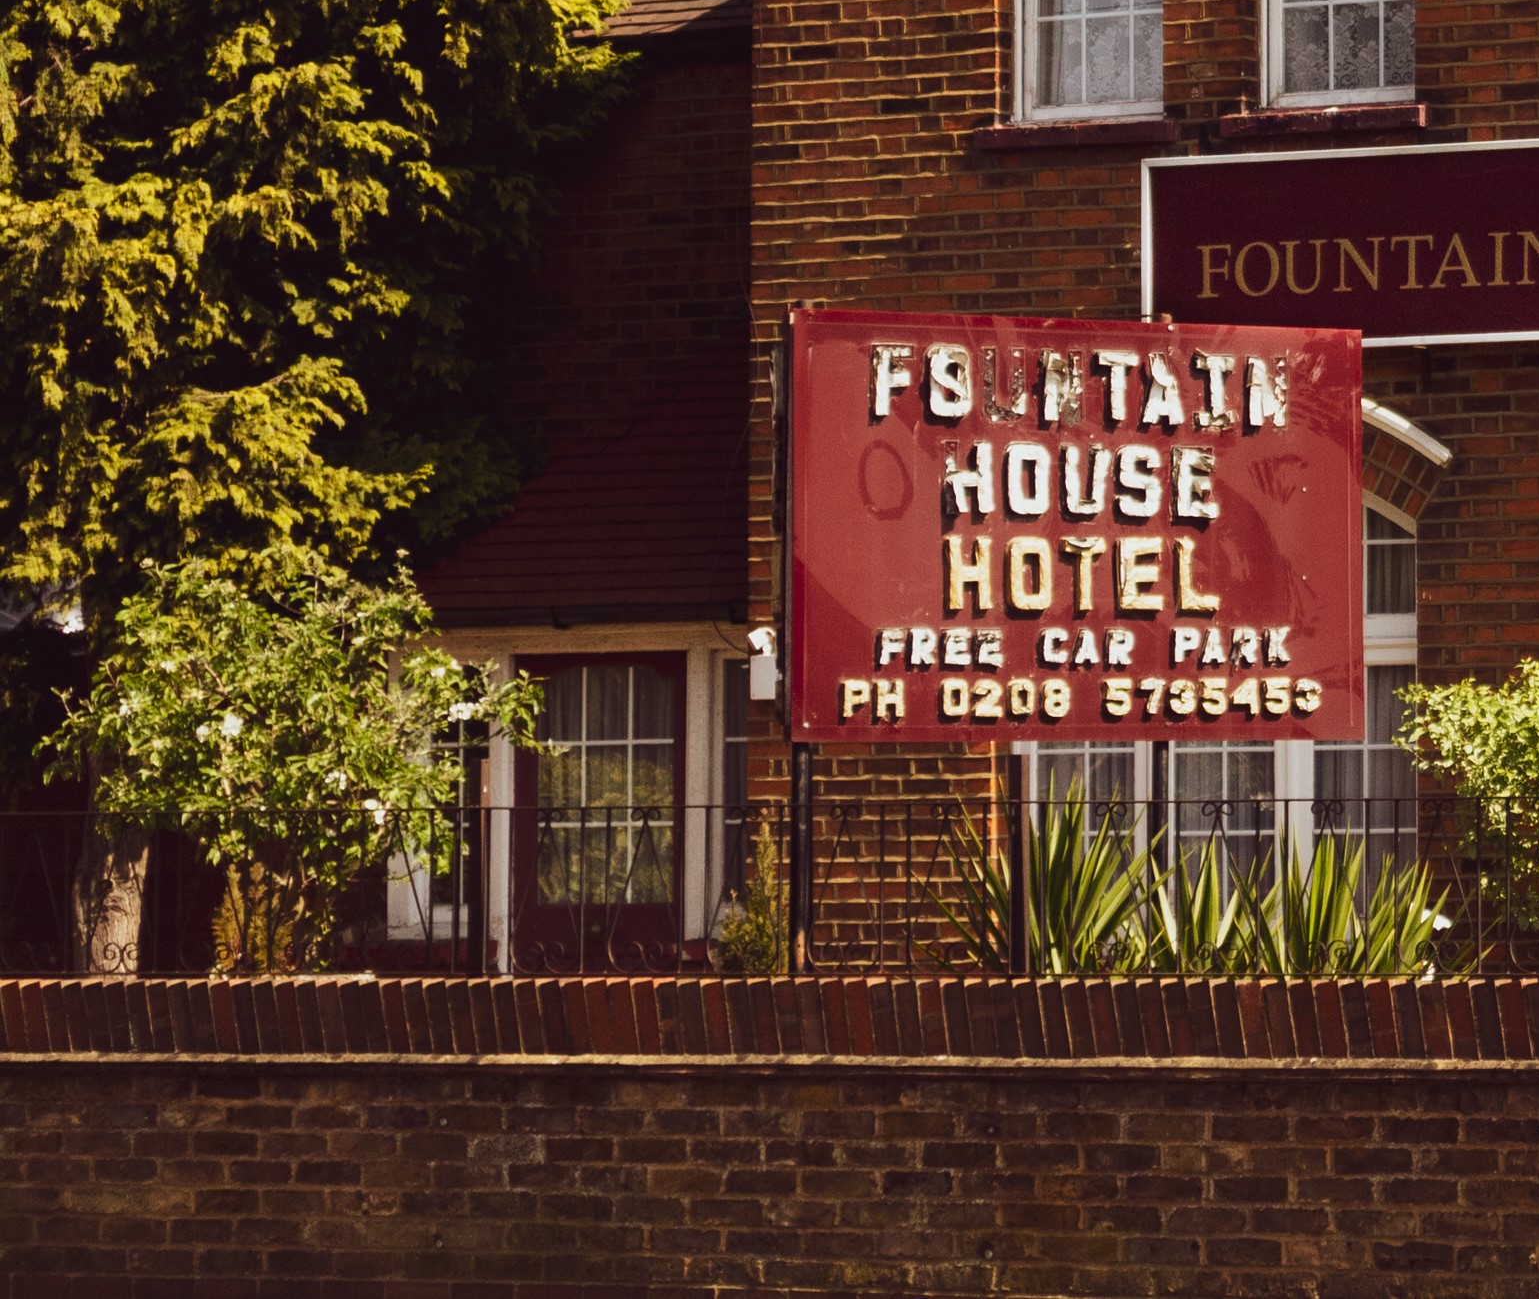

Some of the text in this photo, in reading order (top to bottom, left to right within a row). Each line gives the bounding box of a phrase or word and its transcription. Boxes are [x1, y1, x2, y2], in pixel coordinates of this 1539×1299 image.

[871, 342, 1290, 432] FOUNTAIN
[941, 440, 1220, 522] HOUSE
[943, 535, 1220, 613] HOTEL
[877, 625, 1290, 668] FREE CAR PARK
[840, 677, 1322, 719] PH 0208 5735453
